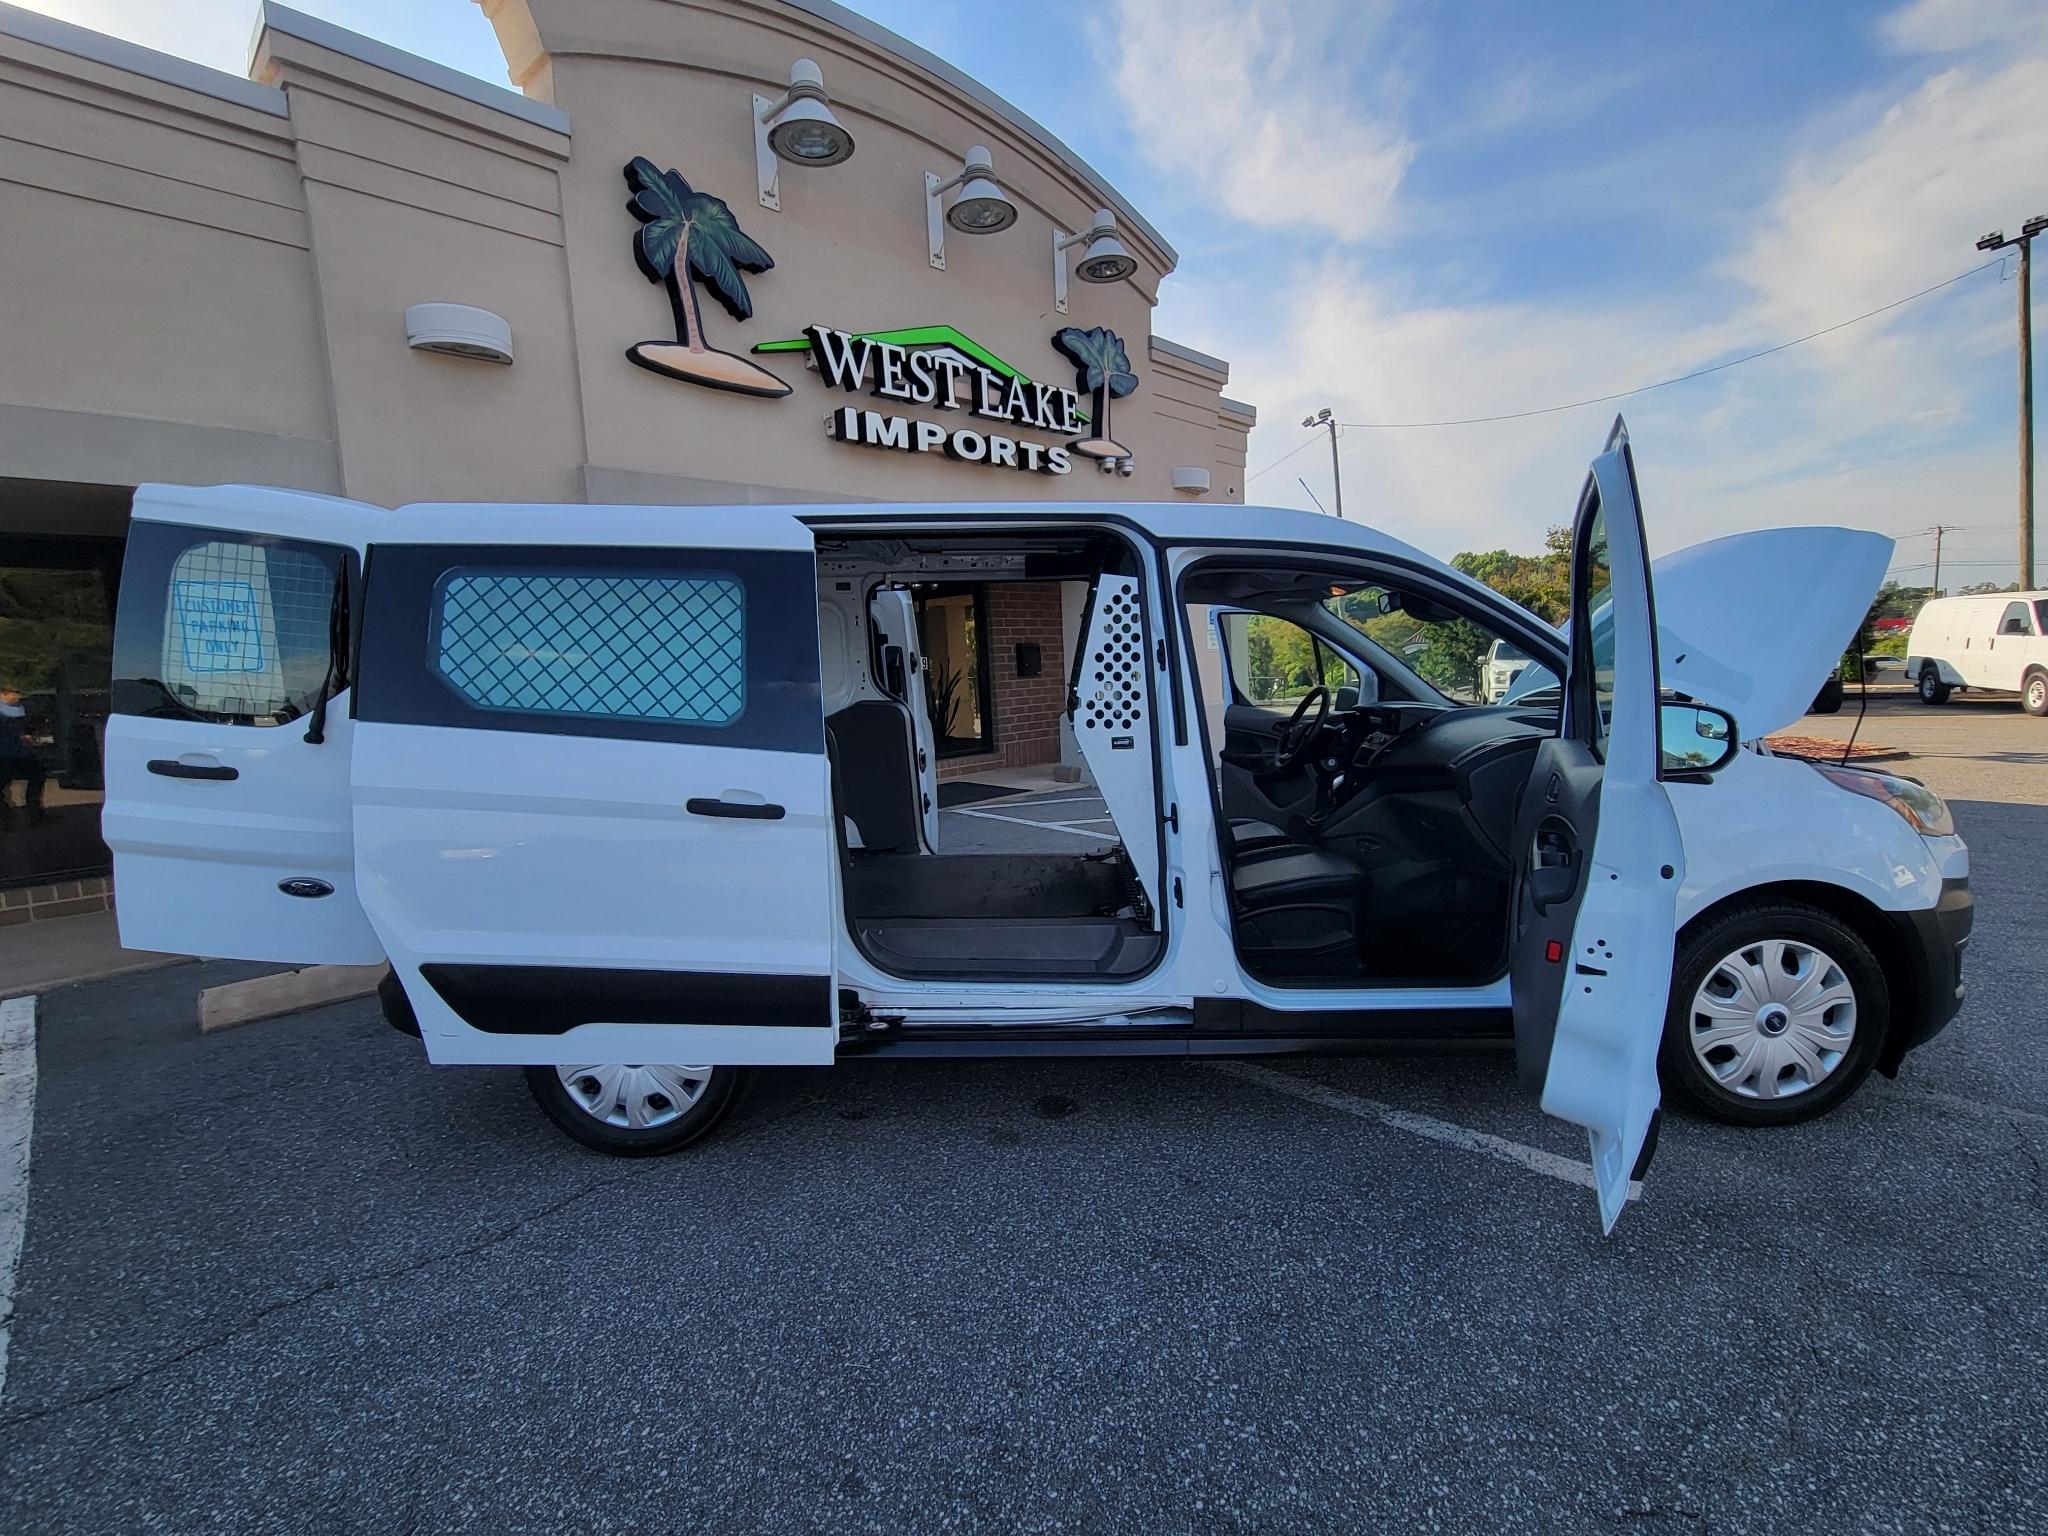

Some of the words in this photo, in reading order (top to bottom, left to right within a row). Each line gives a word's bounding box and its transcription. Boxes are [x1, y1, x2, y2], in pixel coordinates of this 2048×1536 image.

[844, 406, 1072, 475] IMPORTS
[184, 600, 249, 614] CUSTOMER
[191, 620, 248, 633] PARKING
[206, 640, 238, 653] ONLY
